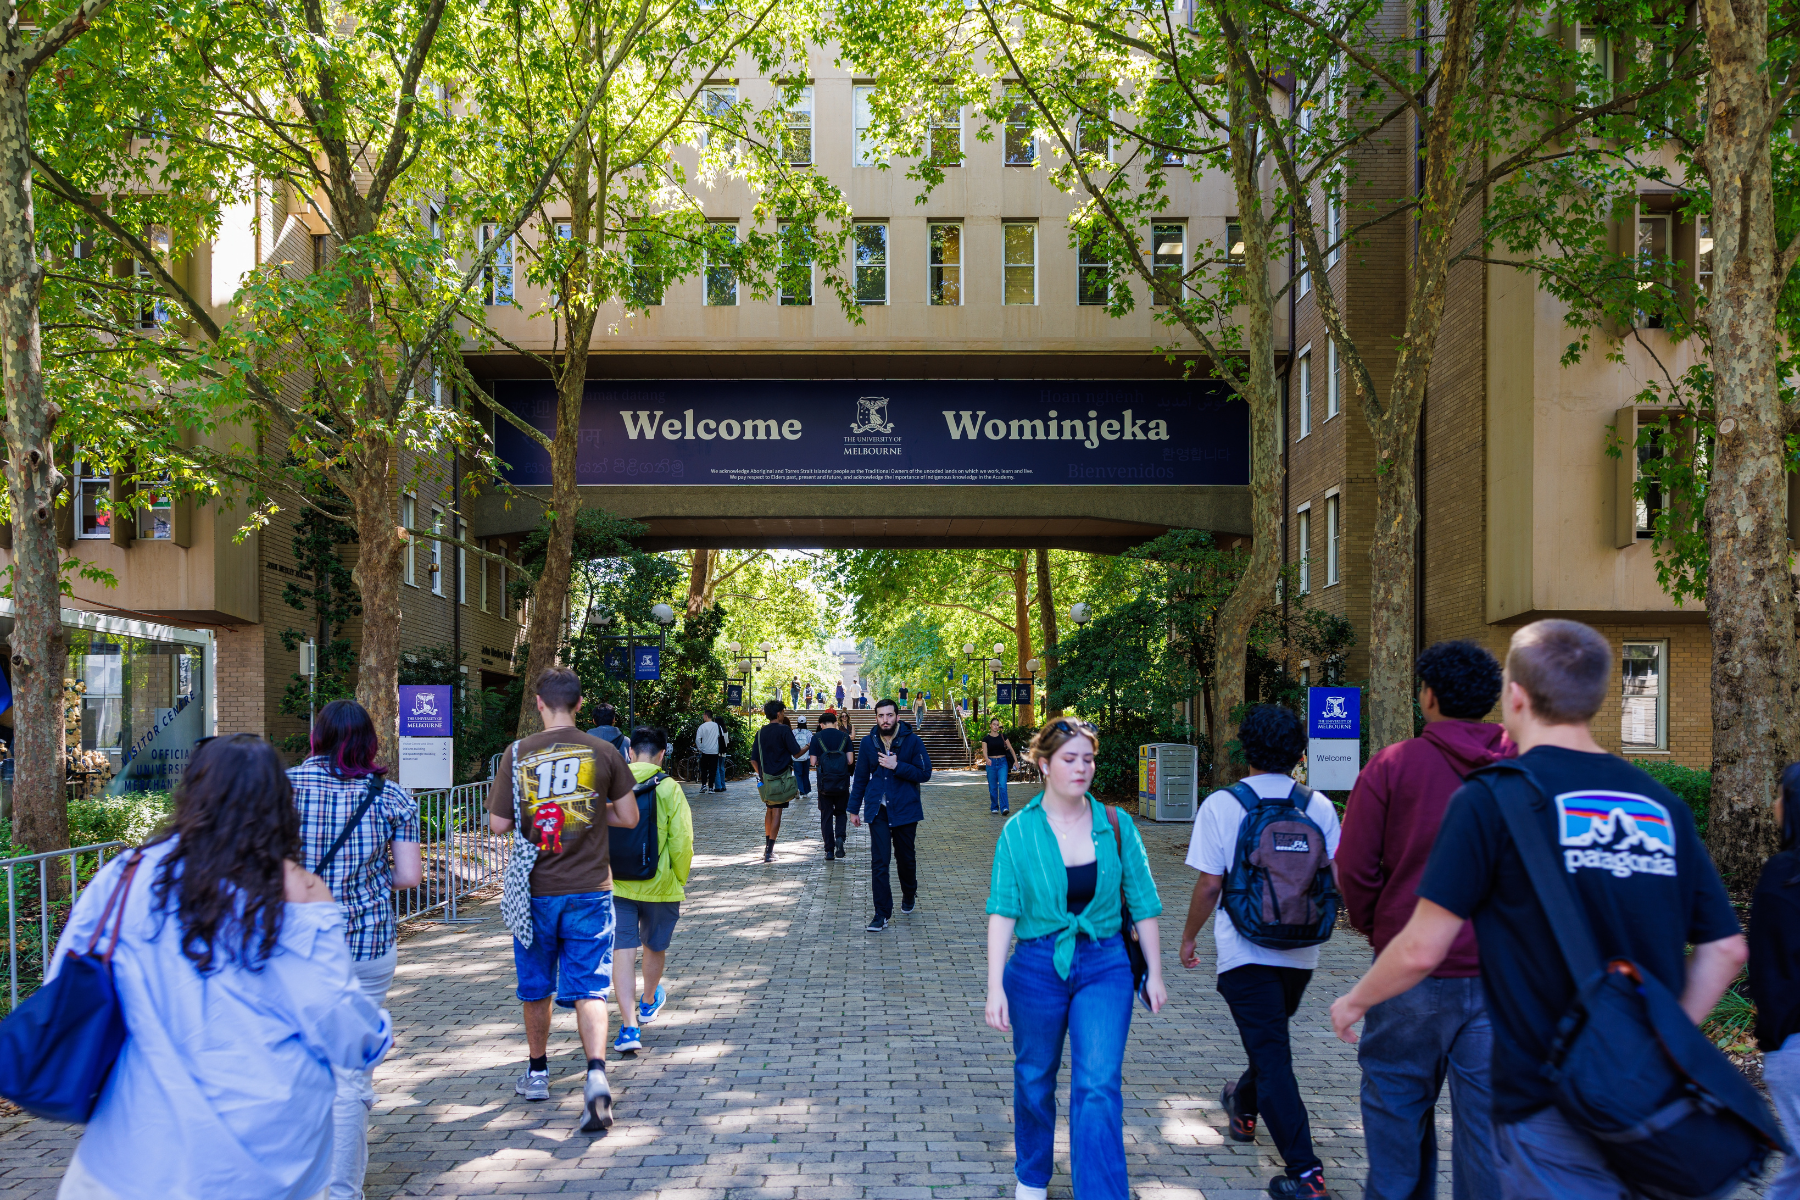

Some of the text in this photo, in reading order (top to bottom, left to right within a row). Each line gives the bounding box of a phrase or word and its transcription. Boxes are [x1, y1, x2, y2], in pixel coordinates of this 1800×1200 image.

[622, 389, 666, 404] datang
[1040, 390, 1080, 403] Hoan
[620, 409, 802, 441] Welcome
[942, 409, 1170, 450] Wominjeka
[1068, 462, 1174, 478] Bienvenidos
[121, 690, 196, 766] VISITOR CENTRE
[151, 749, 192, 760] OFFICIA
[136, 764, 189, 775] UNIVERSIT
[124, 779, 179, 791] MERCHAN
[536, 757, 581, 799] 18
[1563, 848, 1677, 878] patagonia
